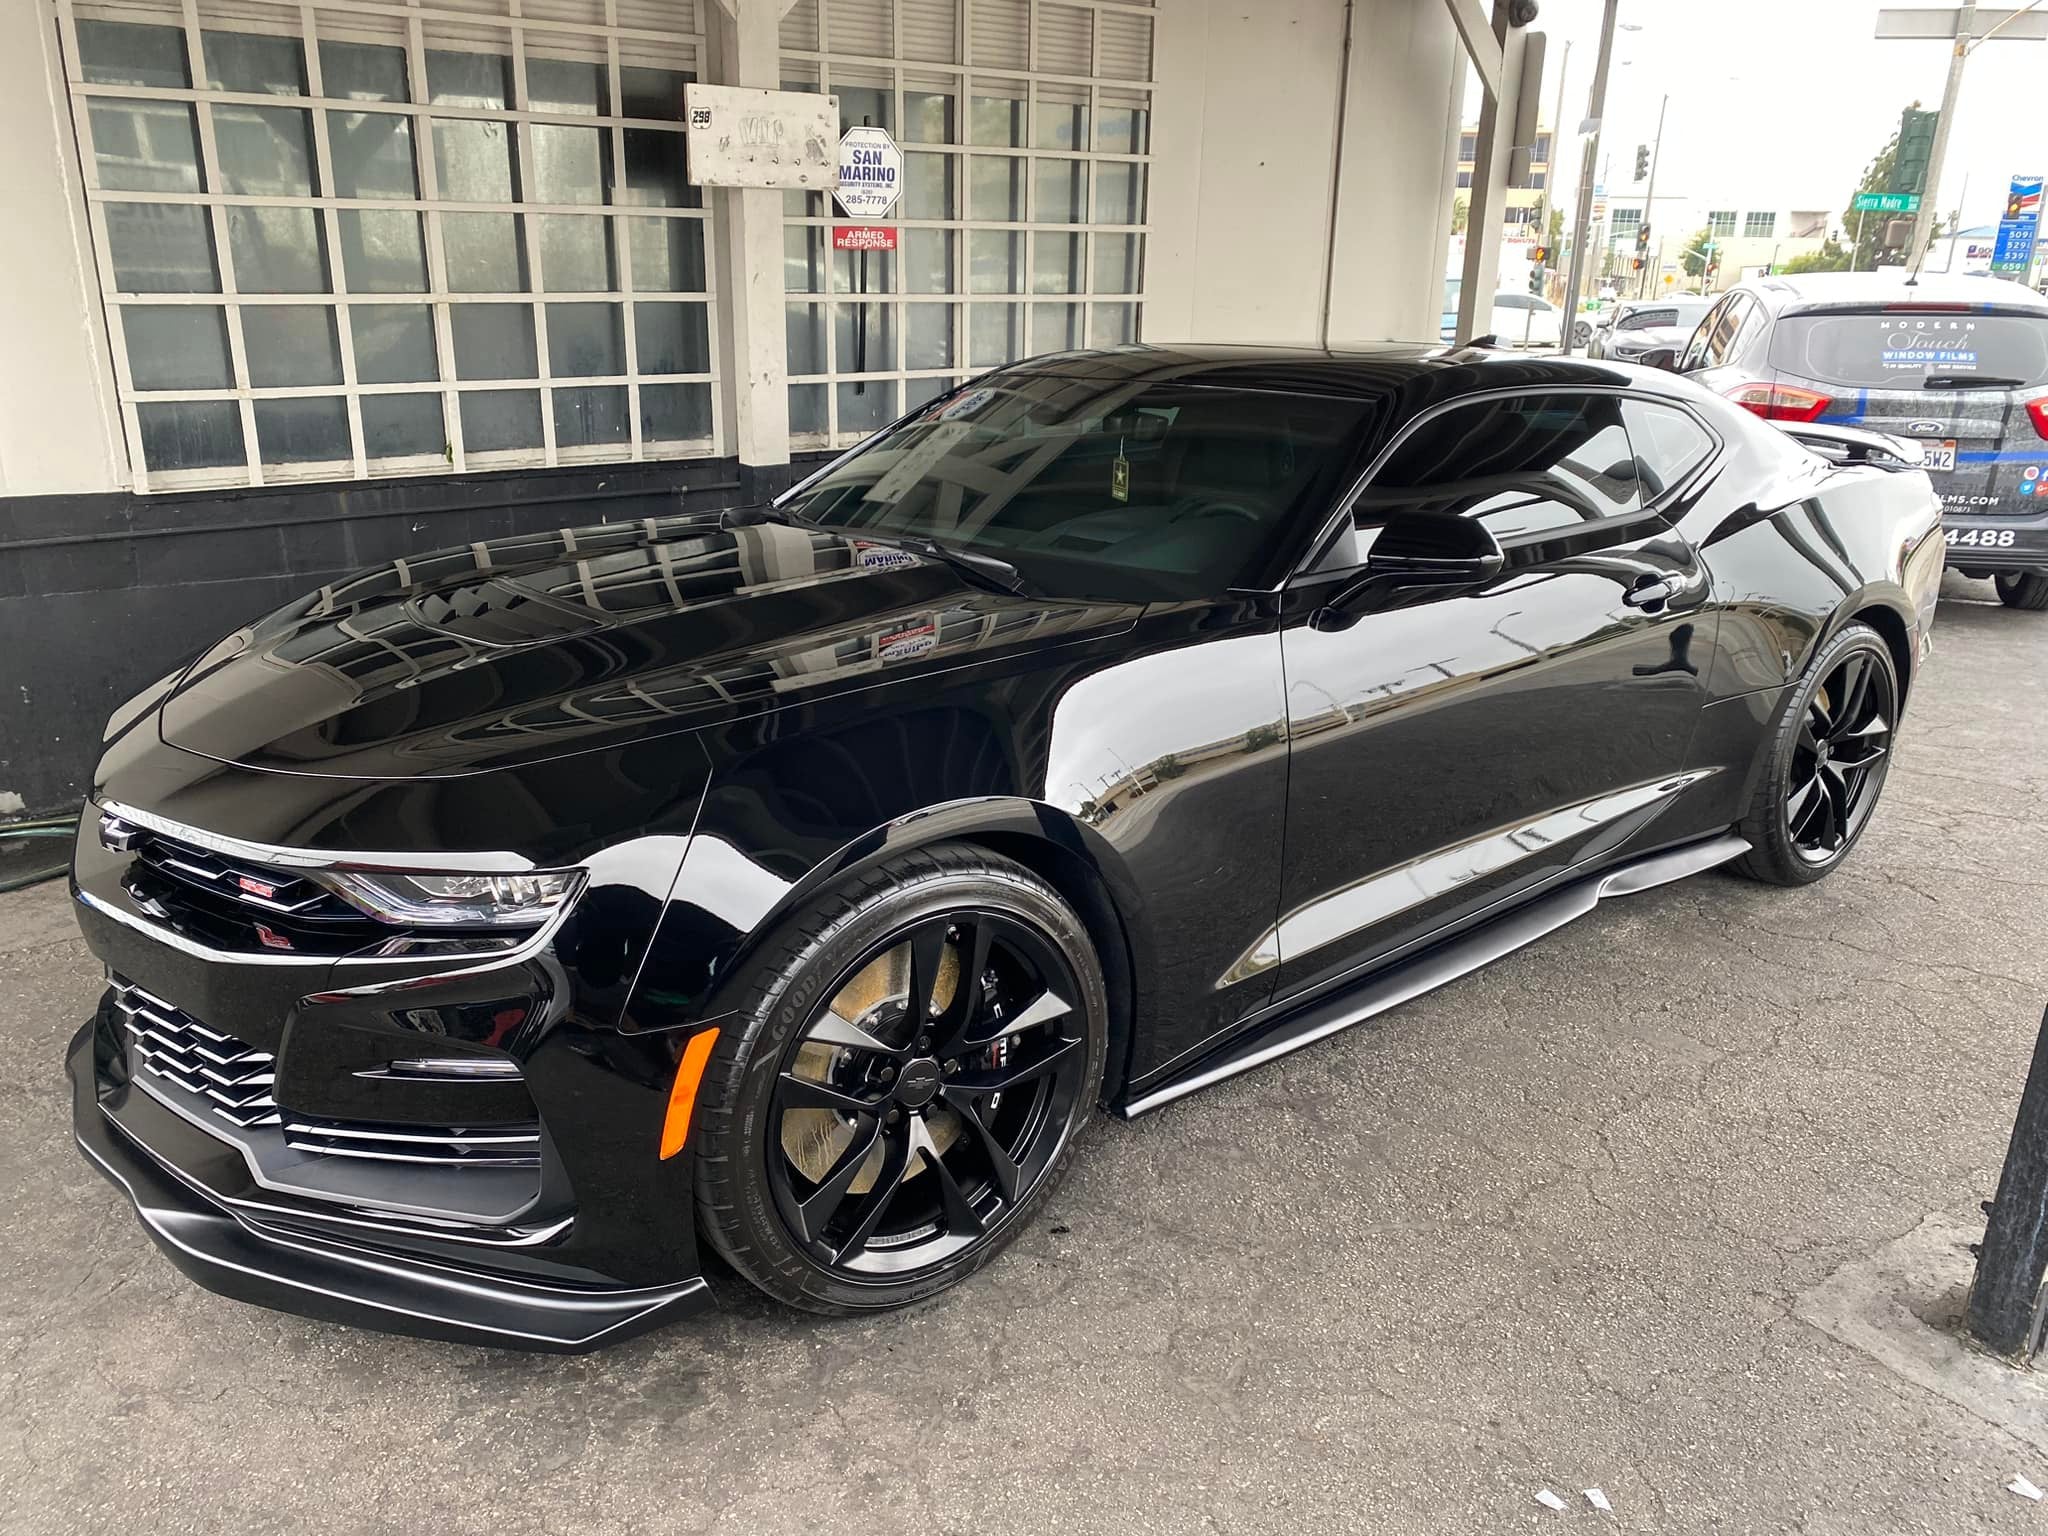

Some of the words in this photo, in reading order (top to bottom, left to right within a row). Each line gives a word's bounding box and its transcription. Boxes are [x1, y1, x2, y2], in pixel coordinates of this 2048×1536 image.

[692, 110, 711, 124] 298
[845, 141, 882, 149] PROTECTION
[852, 149, 882, 166] SAN
[839, 165, 895, 182] MARINO
[2012, 174, 2044, 182] Chevron
[845, 194, 888, 205] 285-7778
[1856, 195, 1879, 209] Sierra
[1880, 195, 1903, 209] Madre
[847, 230, 885, 239] ARMED
[836, 238, 894, 248] RESPONSE
[1880, 321, 1975, 331] MODERN
[1887, 329, 1969, 351] Touch
[1882, 351, 1936, 361] WINDOW
[1939, 351, 1976, 361] FILMS
[1922, 450, 1952, 468] 5W2
[1940, 494, 1999, 506] LMS.COM
[1944, 529, 2016, 547] 4488
